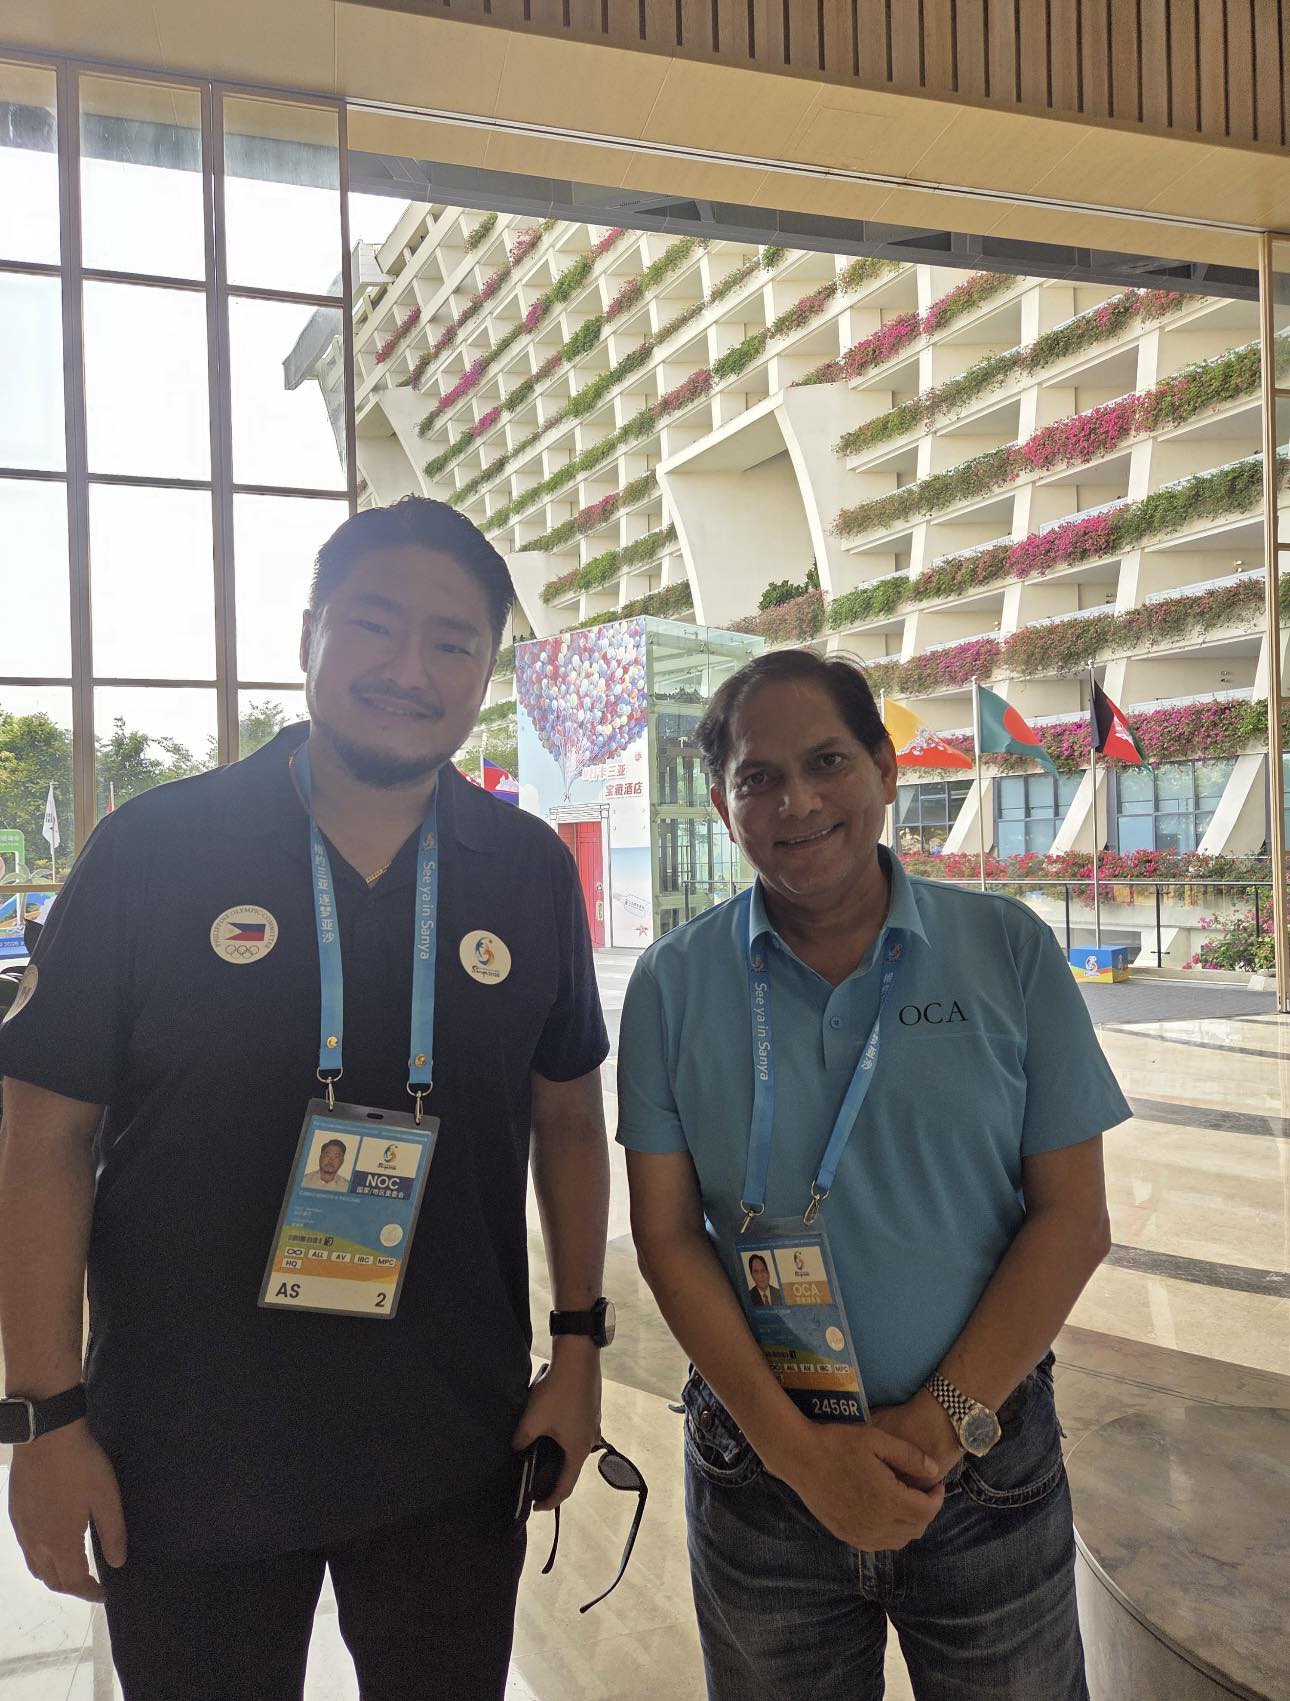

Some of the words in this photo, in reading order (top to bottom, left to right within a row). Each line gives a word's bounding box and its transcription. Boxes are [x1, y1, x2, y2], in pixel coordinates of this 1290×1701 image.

[423, 861, 435, 883] See
[420, 885, 432, 902] ya
[423, 905, 434, 917] in
[420, 920, 434, 960] Sanya
[754, 983, 767, 1006] See
[754, 1008, 766, 1023] ya
[899, 1001, 968, 1026] OCA
[756, 1024, 766, 1037] in
[755, 1041, 771, 1081] Sanya
[366, 1174, 400, 1190] NOC
[285, 1260, 298, 1268] HQ
[378, 1258, 394, 1266] MPC
[275, 1282, 301, 1299] AS
[375, 1292, 387, 1307] 2
[792, 1284, 820, 1297] OCA
[812, 1399, 860, 1416] 2456R
